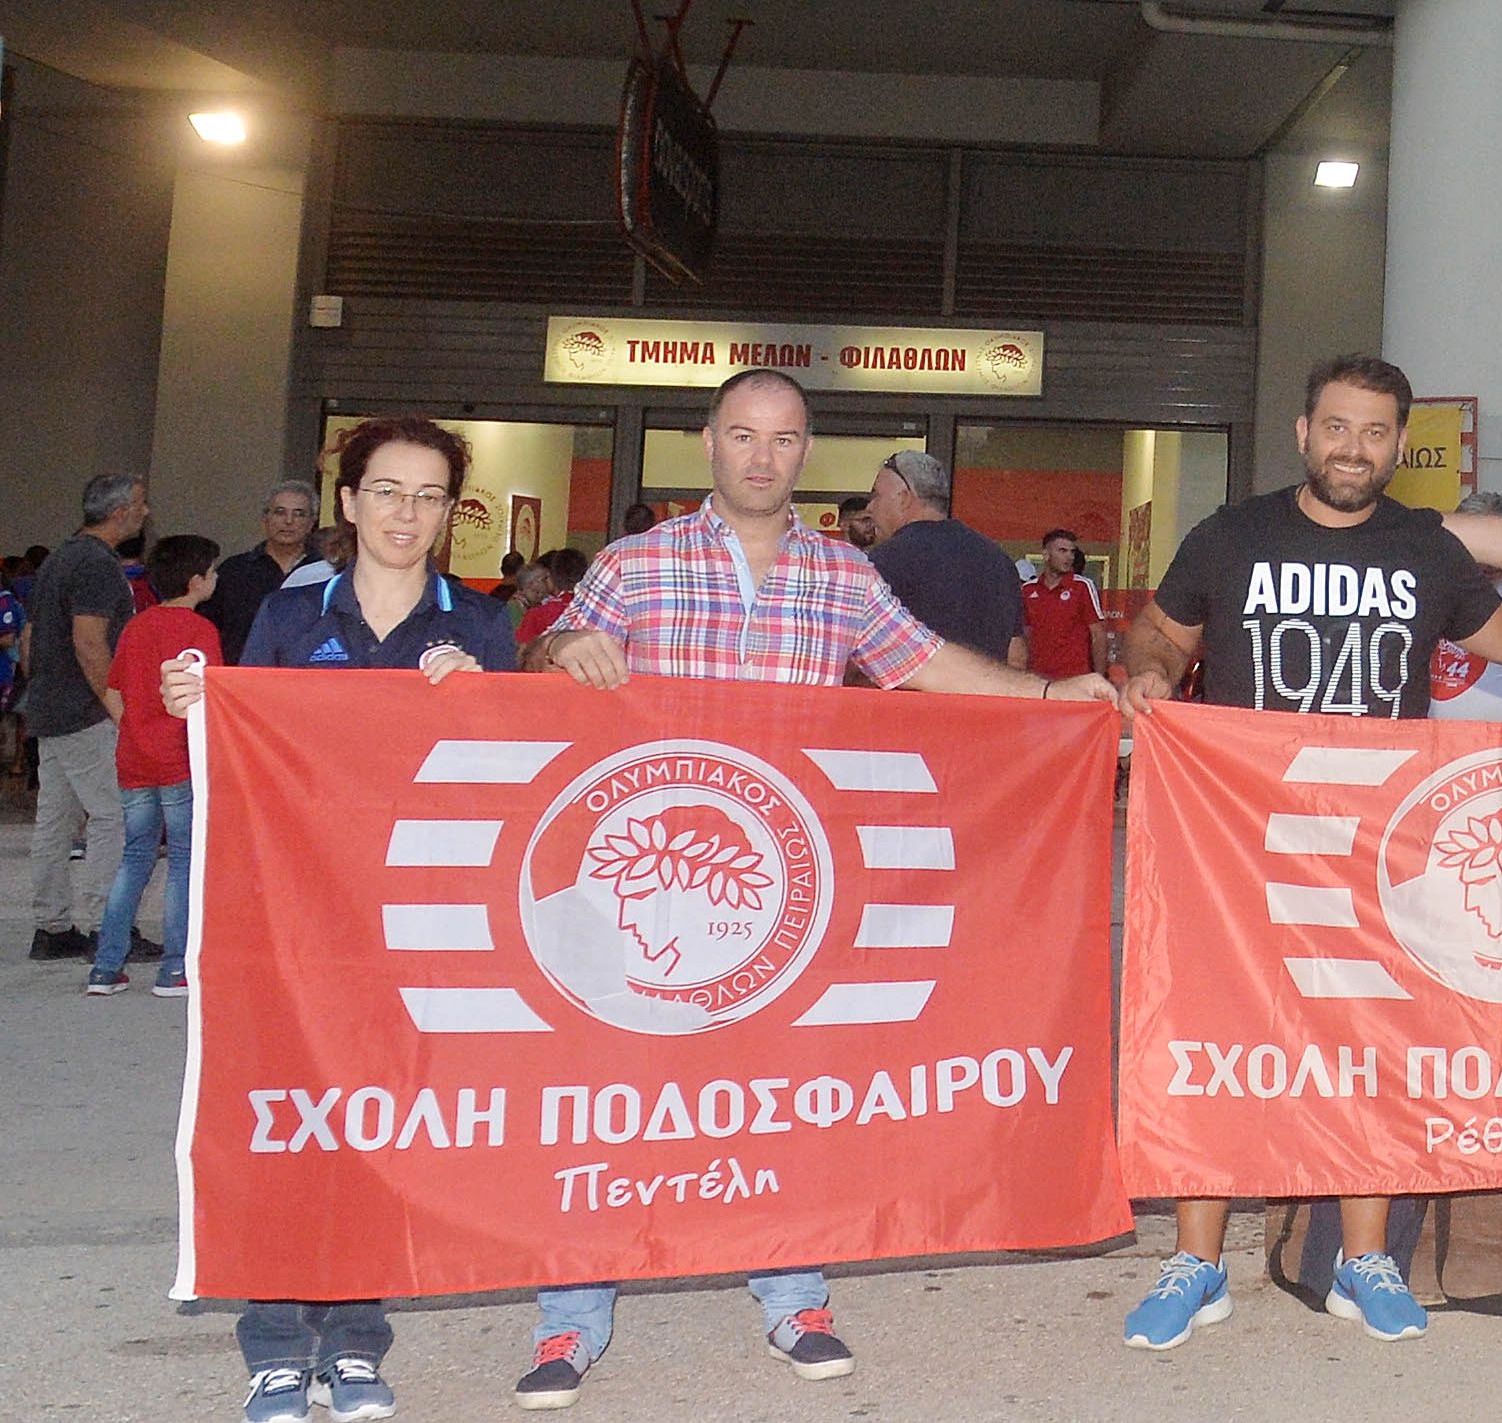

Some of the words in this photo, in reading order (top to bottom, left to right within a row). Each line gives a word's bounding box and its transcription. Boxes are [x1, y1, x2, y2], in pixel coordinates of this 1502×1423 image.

[626, 339, 716, 365] ΤΜΗΜΑ
[729, 341, 812, 368] ΜΕΛΩΝ
[840, 345, 967, 372] ΦΙΛΑΘΛΩΝ
[1243, 562, 1417, 620] ADIDAS
[1243, 619, 1412, 720] 1949
[1447, 662, 1470, 678] 44
[586, 759, 780, 815] ΟΛΥΜΠΙΑΚΟΣ
[775, 820, 812, 950] ΠΕΙΡΑΙΩΣ
[708, 921, 753, 940] 1925
[1167, 1040, 1377, 1099] ΣΧΟΛΗ
[248, 1085, 505, 1155] ΣΧΟΛΗ
[540, 1045, 1074, 1146] ΠΟΔΟΣΦΑΙΡΟΥ
[554, 1156, 780, 1214] Πεντέλη
